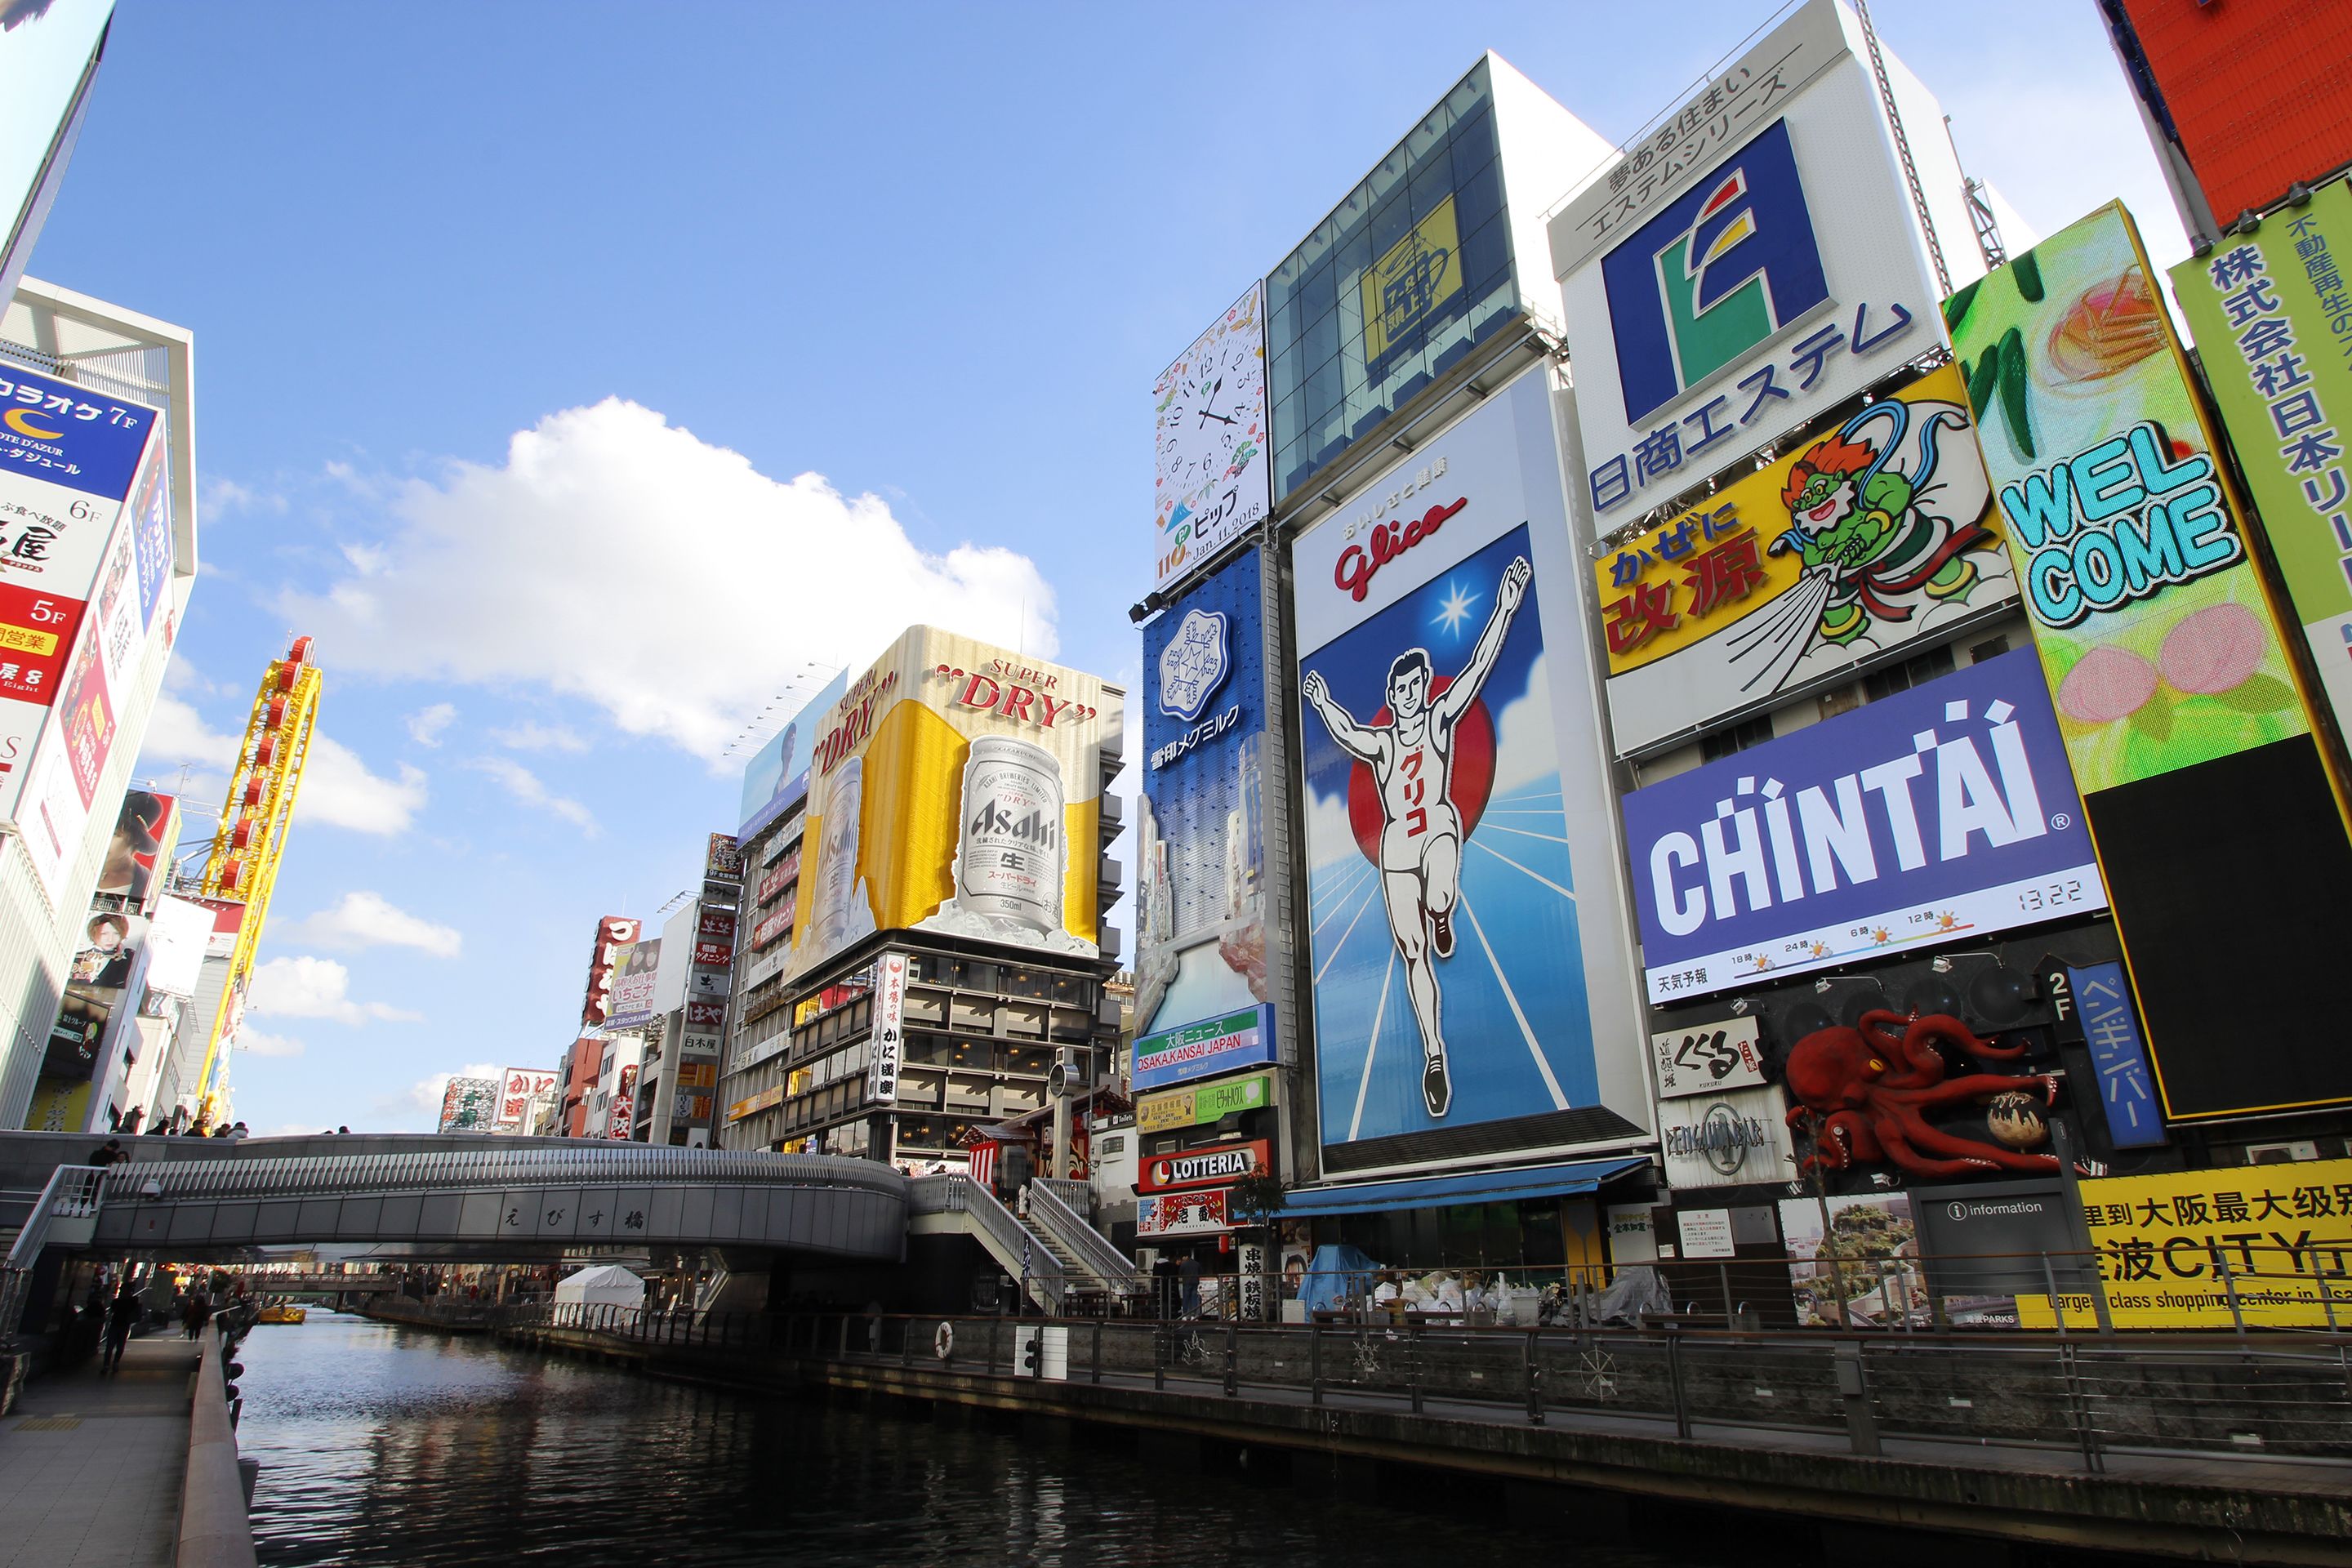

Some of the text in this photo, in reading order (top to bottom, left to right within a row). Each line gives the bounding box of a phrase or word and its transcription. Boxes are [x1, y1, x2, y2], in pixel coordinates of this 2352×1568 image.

[1608, 67, 1750, 194] 夢ある住まい
[1592, 67, 1786, 239] エステムシリーズ
[1200, 357, 1213, 378] 12
[1221, 349, 1227, 366] 1
[1232, 353, 1244, 372] 2
[1183, 380, 1195, 398] 11
[1237, 372, 1250, 389] 3
[109, 406, 137, 430] 7F
[1170, 407, 1183, 429] 10
[1234, 402, 1245, 416] 4
[1588, 302, 1913, 514] 日商エステム
[1166, 439, 1178, 452] 9
[1221, 431, 1231, 448] 5
[1172, 457, 1183, 473] 8
[1186, 462, 1196, 479] 7
[1203, 452, 1212, 470] 6
[2001, 420, 2211, 551] WEL
[1342, 457, 1447, 541] おいしさと健康
[69, 500, 102, 523] 6F
[1195, 485, 1239, 539] ピップ
[1232, 502, 1259, 531] 2018
[1334, 497, 1468, 602] Glico
[1609, 501, 1742, 588] かぜに
[2026, 481, 2243, 625] COME
[1601, 526, 1769, 656] 改源
[30, 599, 66, 624] 5F
[990, 658, 1058, 690] SUPER
[838, 668, 874, 717] SUPER
[1151, 705, 1239, 771] 雪印メグミルク
[1397, 744, 1428, 839] グリコ
[970, 798, 1056, 852] Asahi
[1650, 699, 2047, 937] CHINTAI
[1000, 852, 1025, 872] 生
[988, 871, 1037, 889] スーパードライ
[999, 899, 1022, 911] 350ml
[702, 943, 718, 954] 相席
[1731, 953, 1753, 964] 18時
[1784, 940, 1809, 953] 24時
[1658, 968, 1708, 994] 天気予報
[886, 978, 900, 1022] 本場の味
[684, 1035, 716, 1050] 白木屋
[1165, 1021, 1225, 1049] 大阪ニュース
[880, 1027, 898, 1095] かに道楽
[1138, 1033, 1241, 1071] OSAKA,KANSAI JAPAN
[1659, 1038, 1677, 1089] 道頓堀
[1674, 1030, 1740, 1080] くくる
[2082, 977, 2148, 1128] ペンギンバー
[510, 1074, 555, 1094] かに
[1699, 1080, 1722, 1089] KUKURU
[1173, 1152, 1245, 1179] LOTTERIA
[506, 1208, 644, 1230] えびす橋
[1178, 1205, 1209, 1224] 壱番
[1968, 1200, 2043, 1218] information
[2110, 1292, 2152, 1309] class
